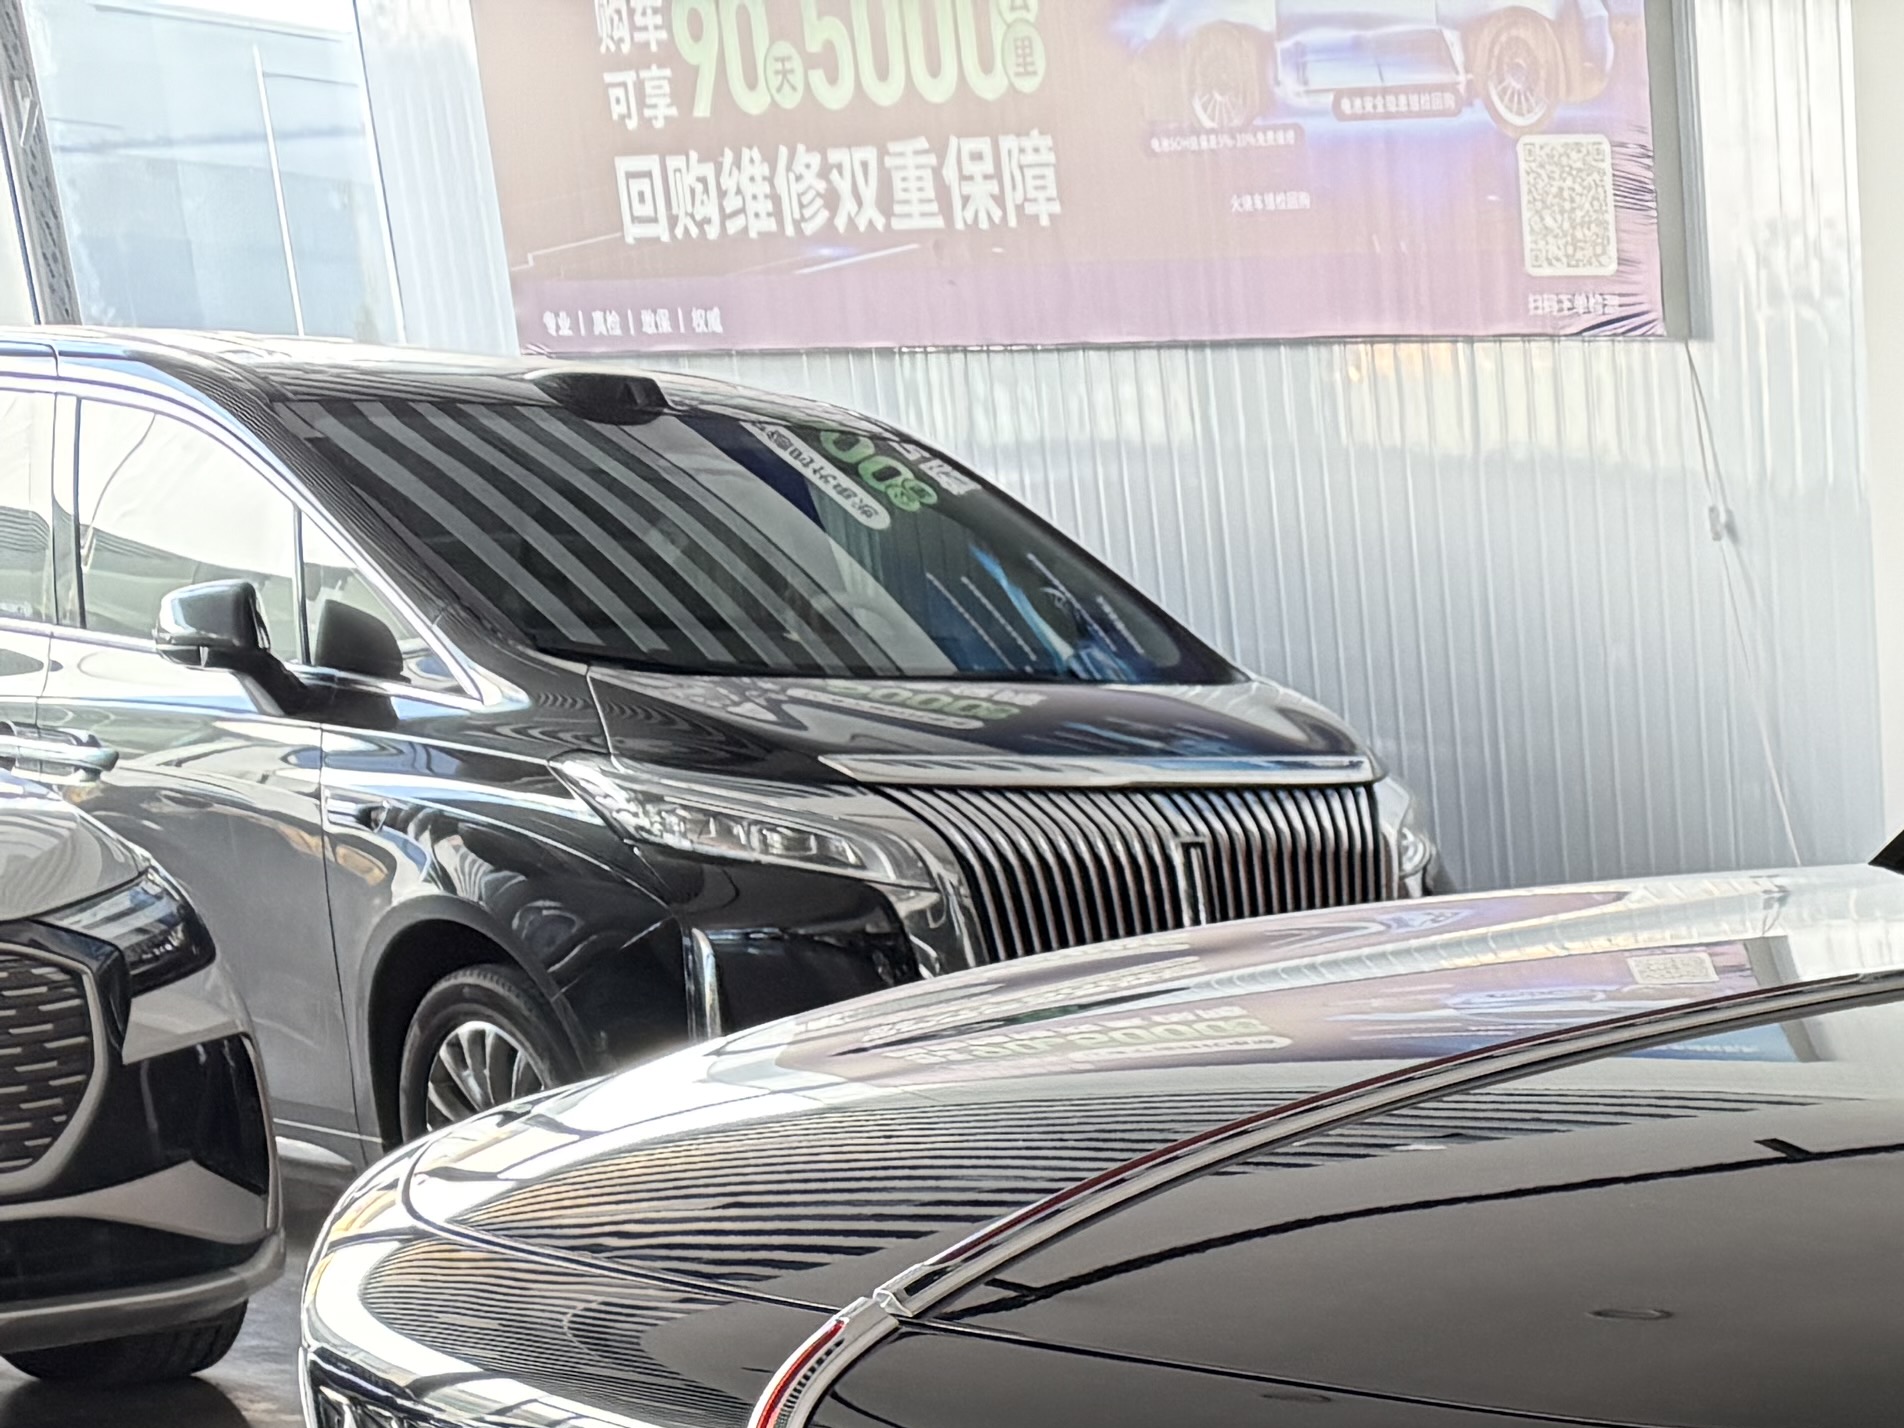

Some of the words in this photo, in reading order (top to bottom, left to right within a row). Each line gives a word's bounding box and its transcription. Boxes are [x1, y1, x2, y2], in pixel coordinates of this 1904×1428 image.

[595, 0, 668, 54] 购车
[603, 63, 679, 130] 可享
[614, 128, 1062, 244] 回购维修双重保障
